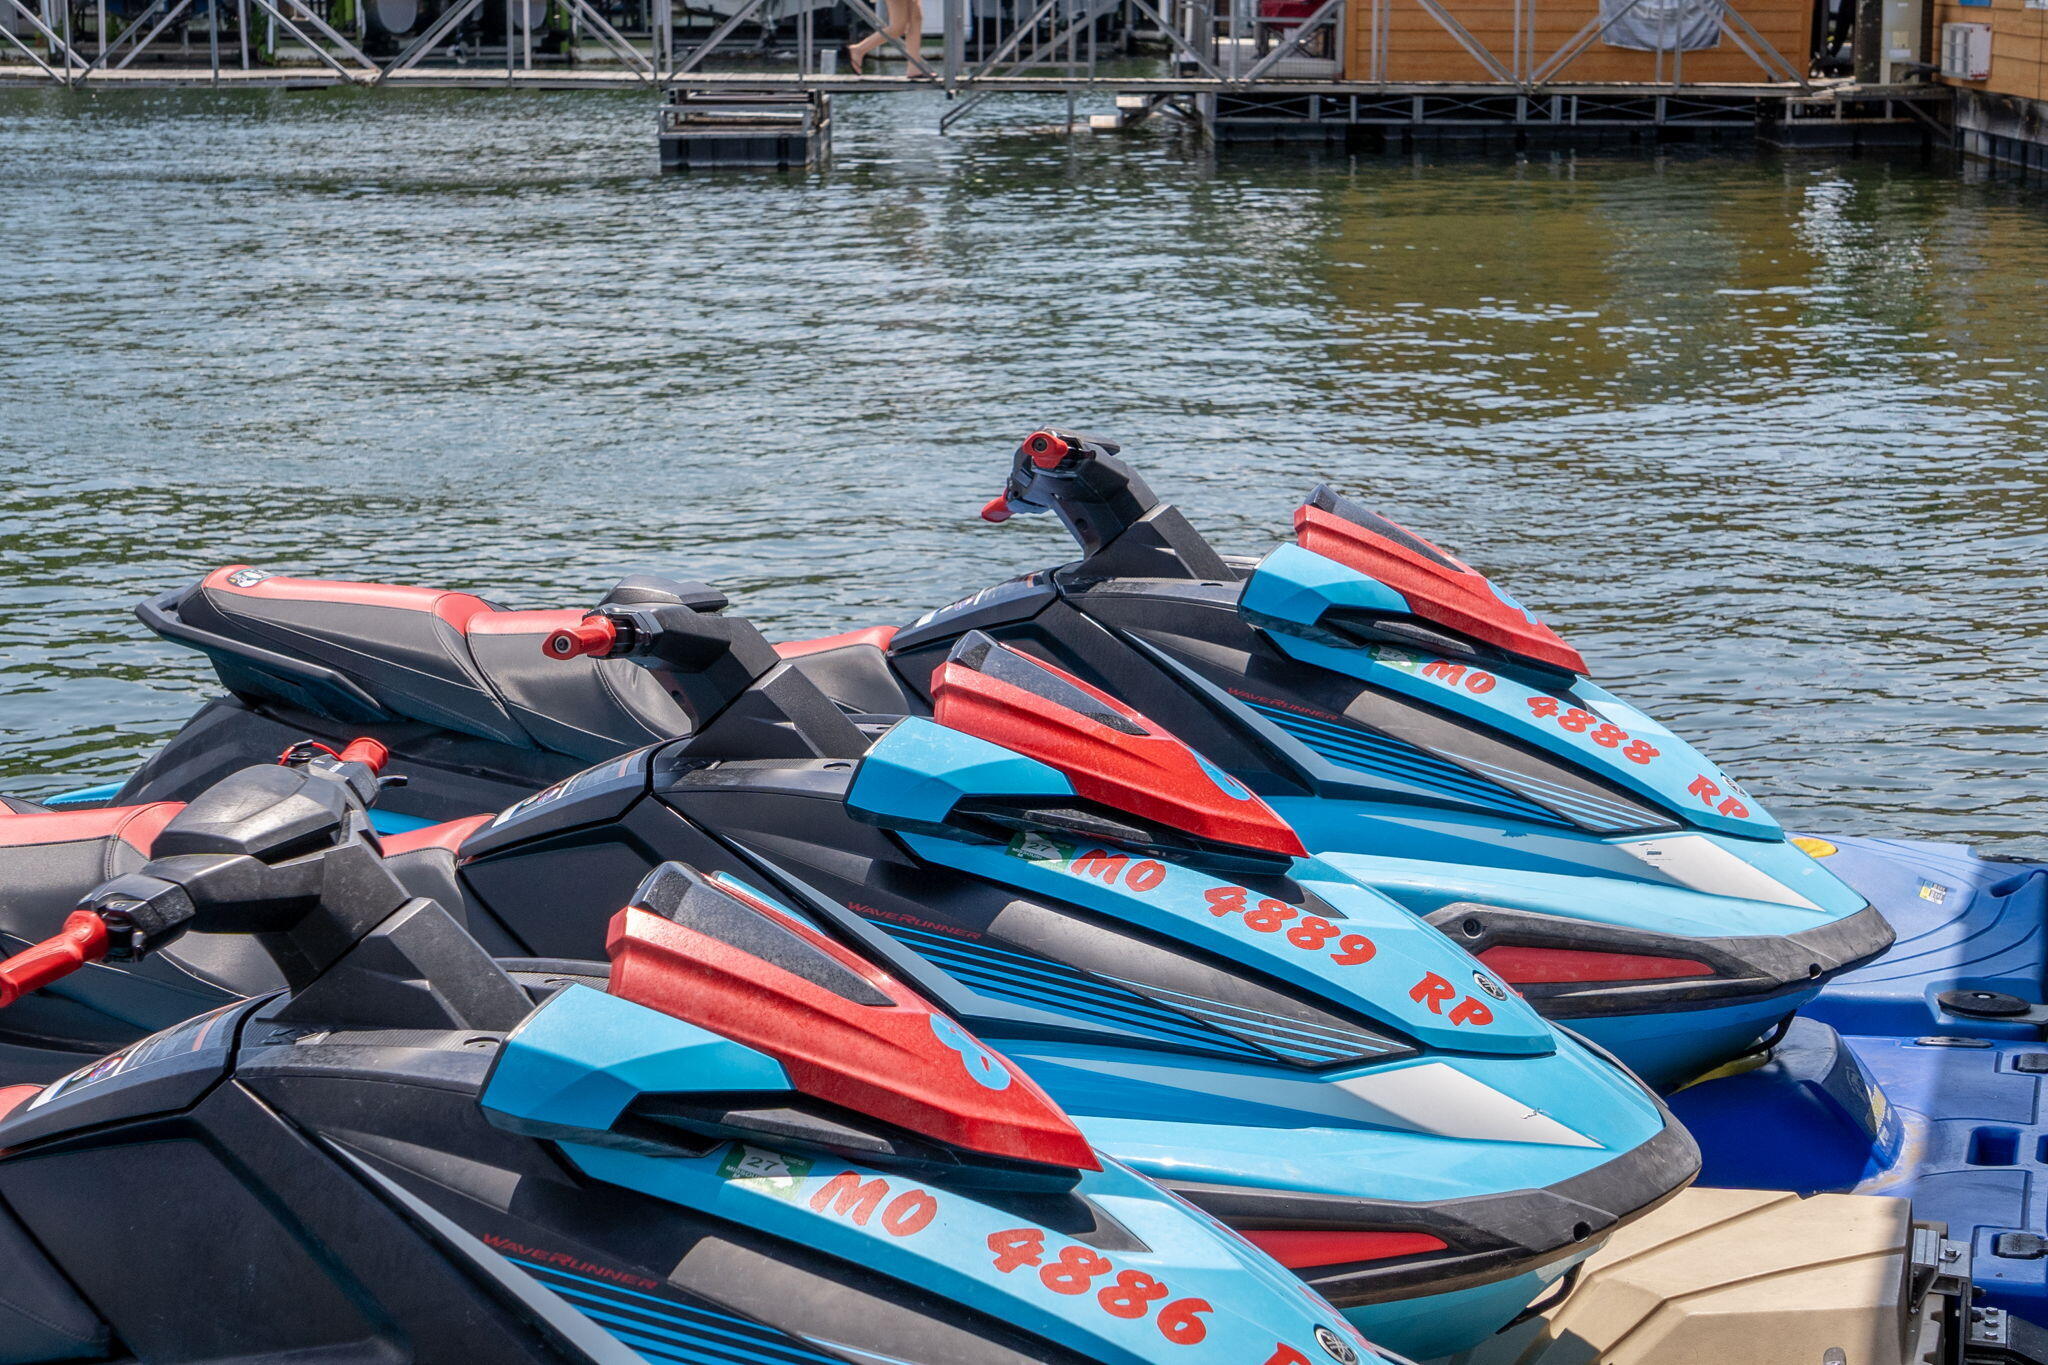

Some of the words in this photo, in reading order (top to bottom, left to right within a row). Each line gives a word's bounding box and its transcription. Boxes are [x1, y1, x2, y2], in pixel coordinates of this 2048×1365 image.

[1422, 660, 1496, 694] MO
[1527, 696, 1660, 765] 4888
[1688, 774, 1749, 819] RP
[1070, 848, 1167, 893] MO
[1204, 886, 1377, 966] 4889
[1408, 970, 1494, 1027] RP
[746, 1156, 780, 1172] 27
[809, 1170, 937, 1238] MO
[987, 1227, 1214, 1345] 4886
